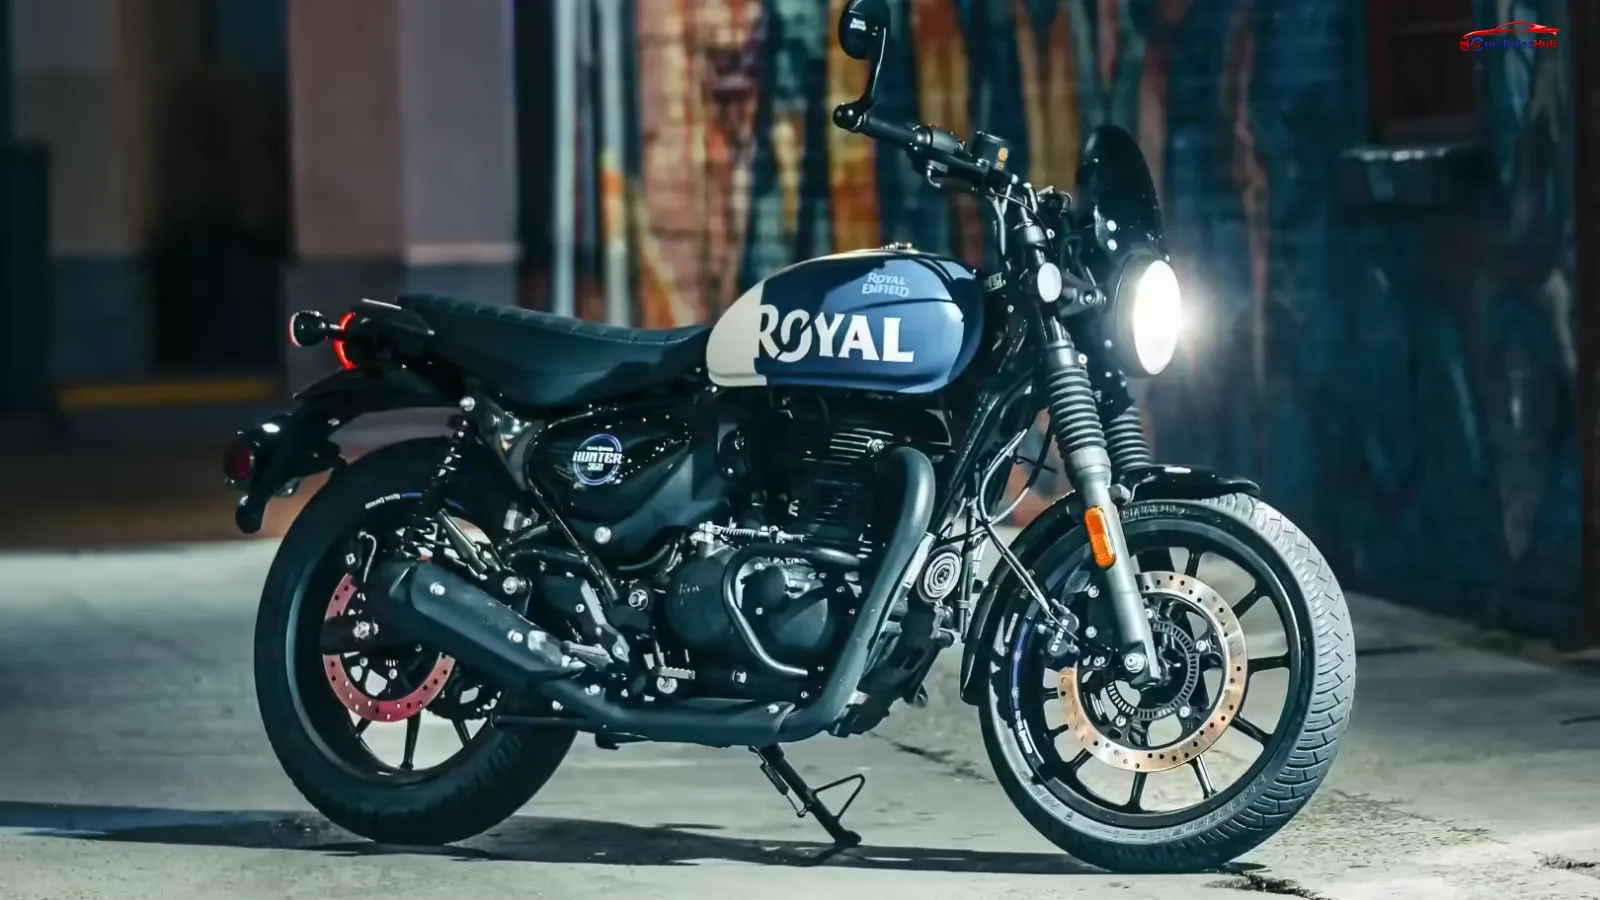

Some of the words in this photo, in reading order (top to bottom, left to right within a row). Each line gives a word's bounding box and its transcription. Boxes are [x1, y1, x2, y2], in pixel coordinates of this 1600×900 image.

[867, 272, 906, 286] ROYAL
[861, 283, 911, 298] ENFIELD
[758, 303, 915, 363] ROYAL
[572, 451, 622, 465] HUNTER
